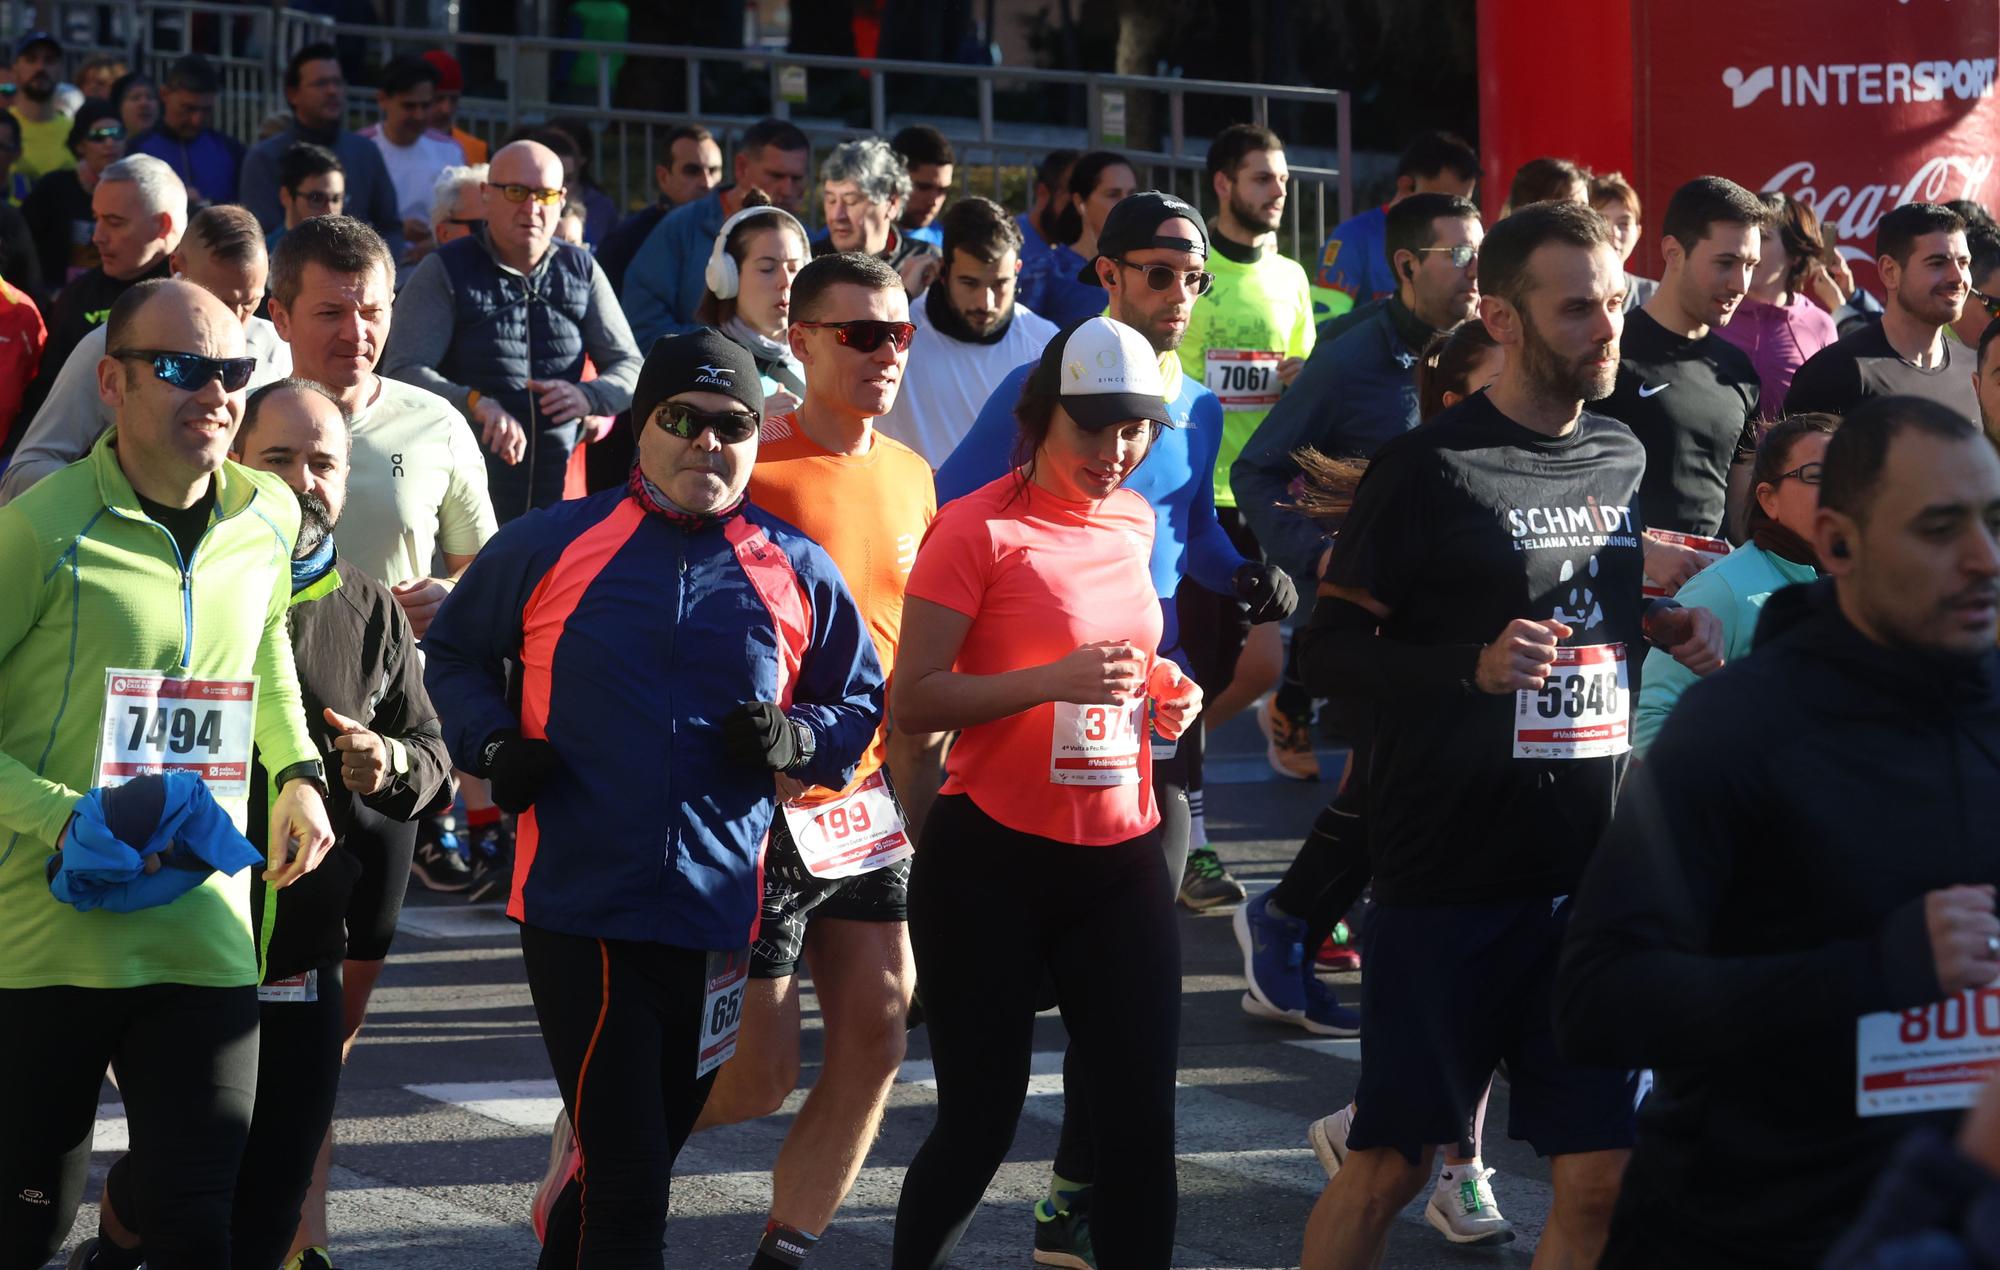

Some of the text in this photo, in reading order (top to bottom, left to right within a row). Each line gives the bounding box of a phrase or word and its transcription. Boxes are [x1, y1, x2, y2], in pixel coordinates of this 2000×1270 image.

[1780, 58, 1996, 107] INTERSPORT
[1220, 365, 1270, 391] 7067
[1513, 535, 1638, 551] L'ELIANA VLC RUNNING
[1536, 672, 1618, 718] 5348
[127, 706, 222, 754] 7494
[1070, 744, 1085, 752] Volta
[814, 801, 872, 842] 199
